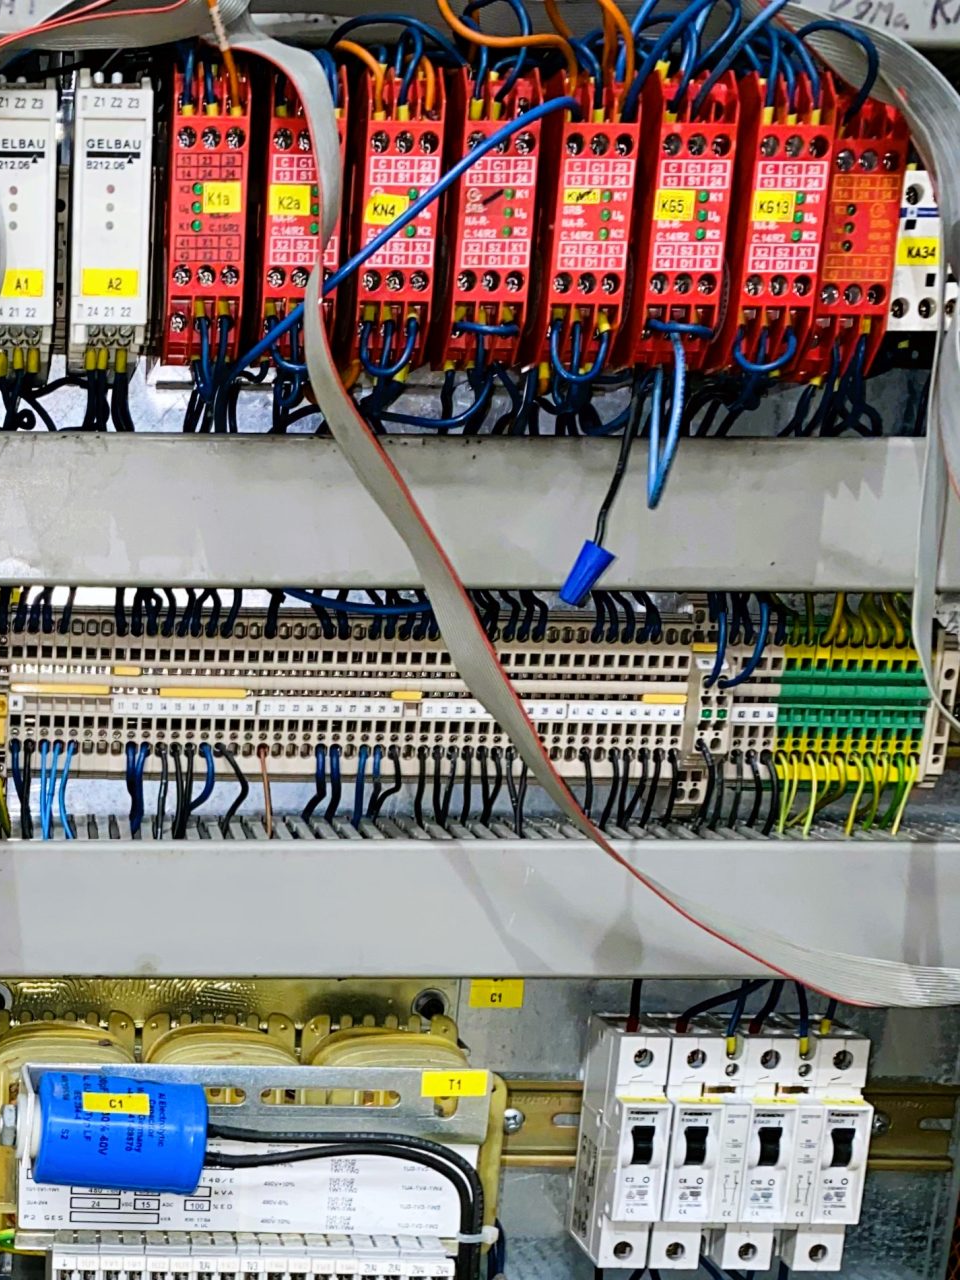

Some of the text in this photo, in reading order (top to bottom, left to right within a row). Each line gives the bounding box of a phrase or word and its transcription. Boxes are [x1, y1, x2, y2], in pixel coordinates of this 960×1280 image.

[14, 97, 27, 109] Z2
[31, 98, 44, 110] Z3
[93, 96, 140, 109] Z1 Z2 Z3
[86, 139, 142, 150] GELBAU
[86, 160, 126, 171] B212.06
[299, 158, 313, 168] C1
[396, 160, 433, 170] C1 23
[493, 160, 528, 170] C1 23
[278, 171, 313, 181] 13 S1
[376, 173, 388, 183] 13
[471, 174, 483, 183] 13
[762, 177, 774, 187] 13
[806, 178, 820, 187] 24
[207, 191, 231, 206] K1a
[278, 196, 301, 210] K2a
[372, 203, 396, 217] KN4
[907, 246, 937, 259] KA34
[753, 261, 767, 271] 14
[14, 277, 30, 291] A1
[107, 277, 123, 291] A2
[8, 306, 20, 317] 21
[25, 306, 37, 317] 22
[87, 306, 132, 317] 24 21 22
[489, 991, 503, 1004] C1
[448, 1078, 462, 1091] T1
[108, 1099, 124, 1109] C1
[91, 1200, 101, 1208] 24
[190, 1202, 205, 1210] 100
